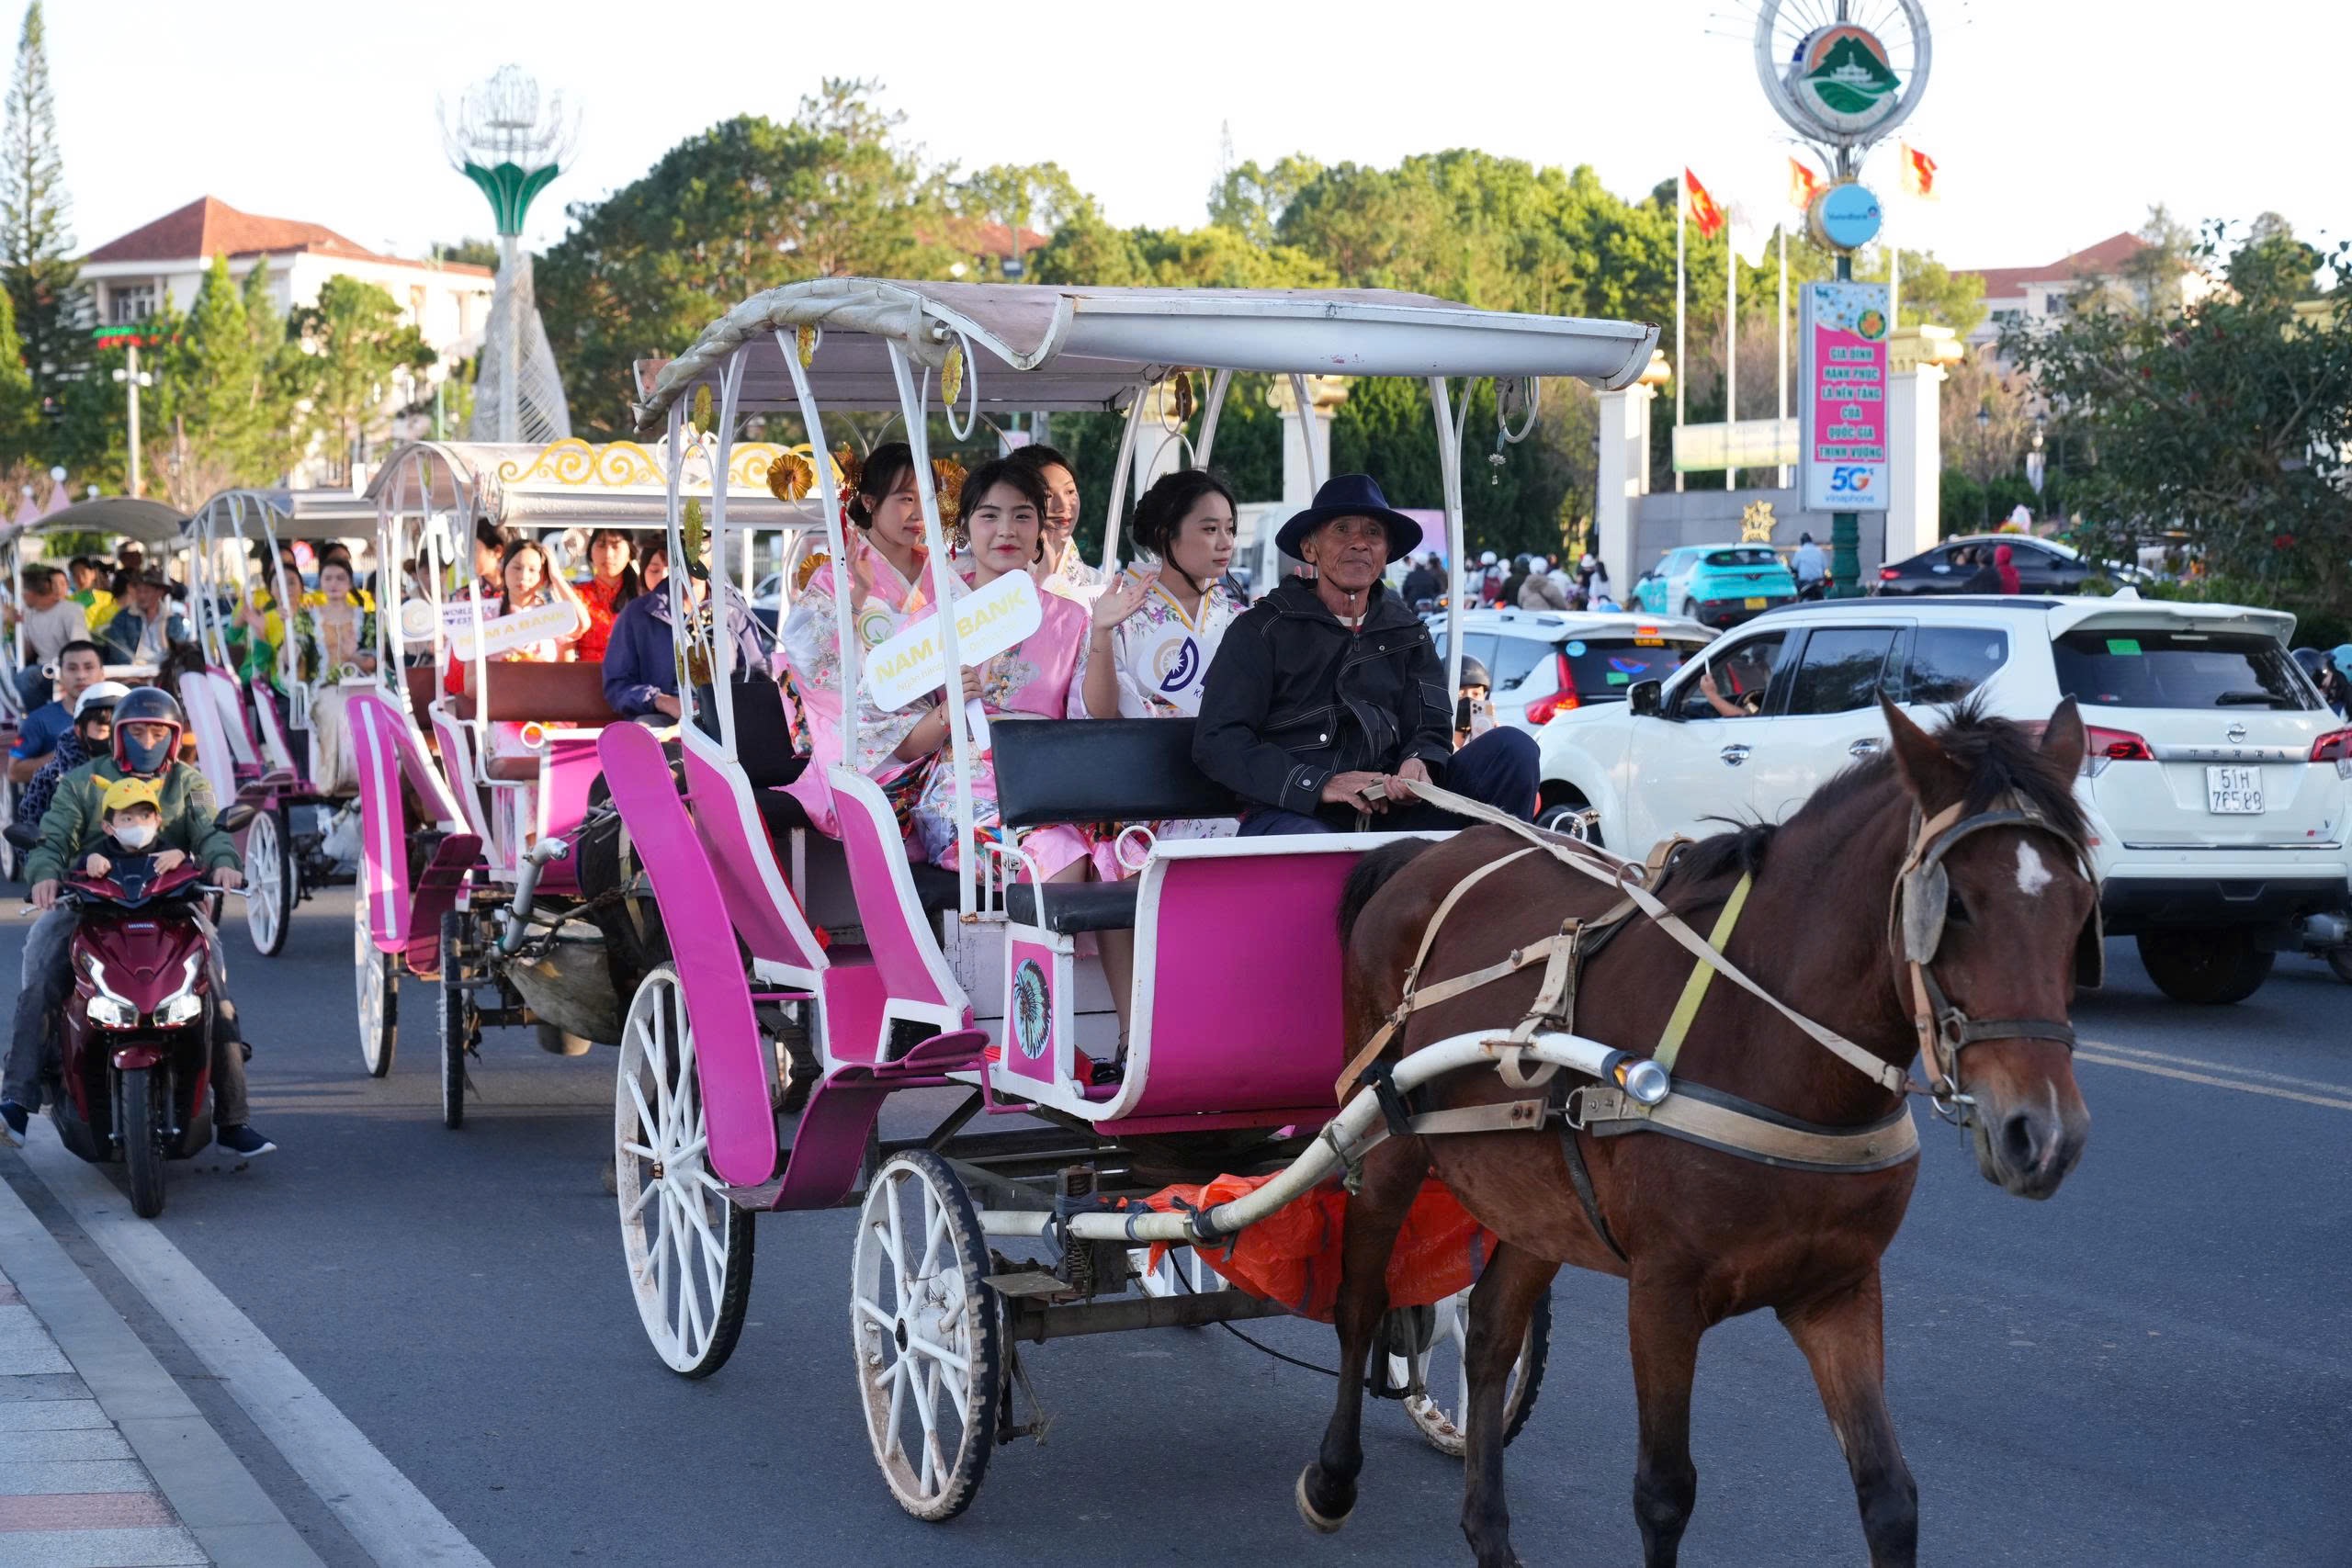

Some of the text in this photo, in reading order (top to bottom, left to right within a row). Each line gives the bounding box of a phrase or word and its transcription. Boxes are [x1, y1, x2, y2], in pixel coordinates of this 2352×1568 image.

[1830, 348, 1846, 360] GIA
[1858, 426, 1873, 439] GIA
[876, 639, 933, 682] NAM
[956, 588, 1027, 639] BANK
[2189, 749, 2286, 759] TERRA
[2221, 769, 2250, 789] 51H
